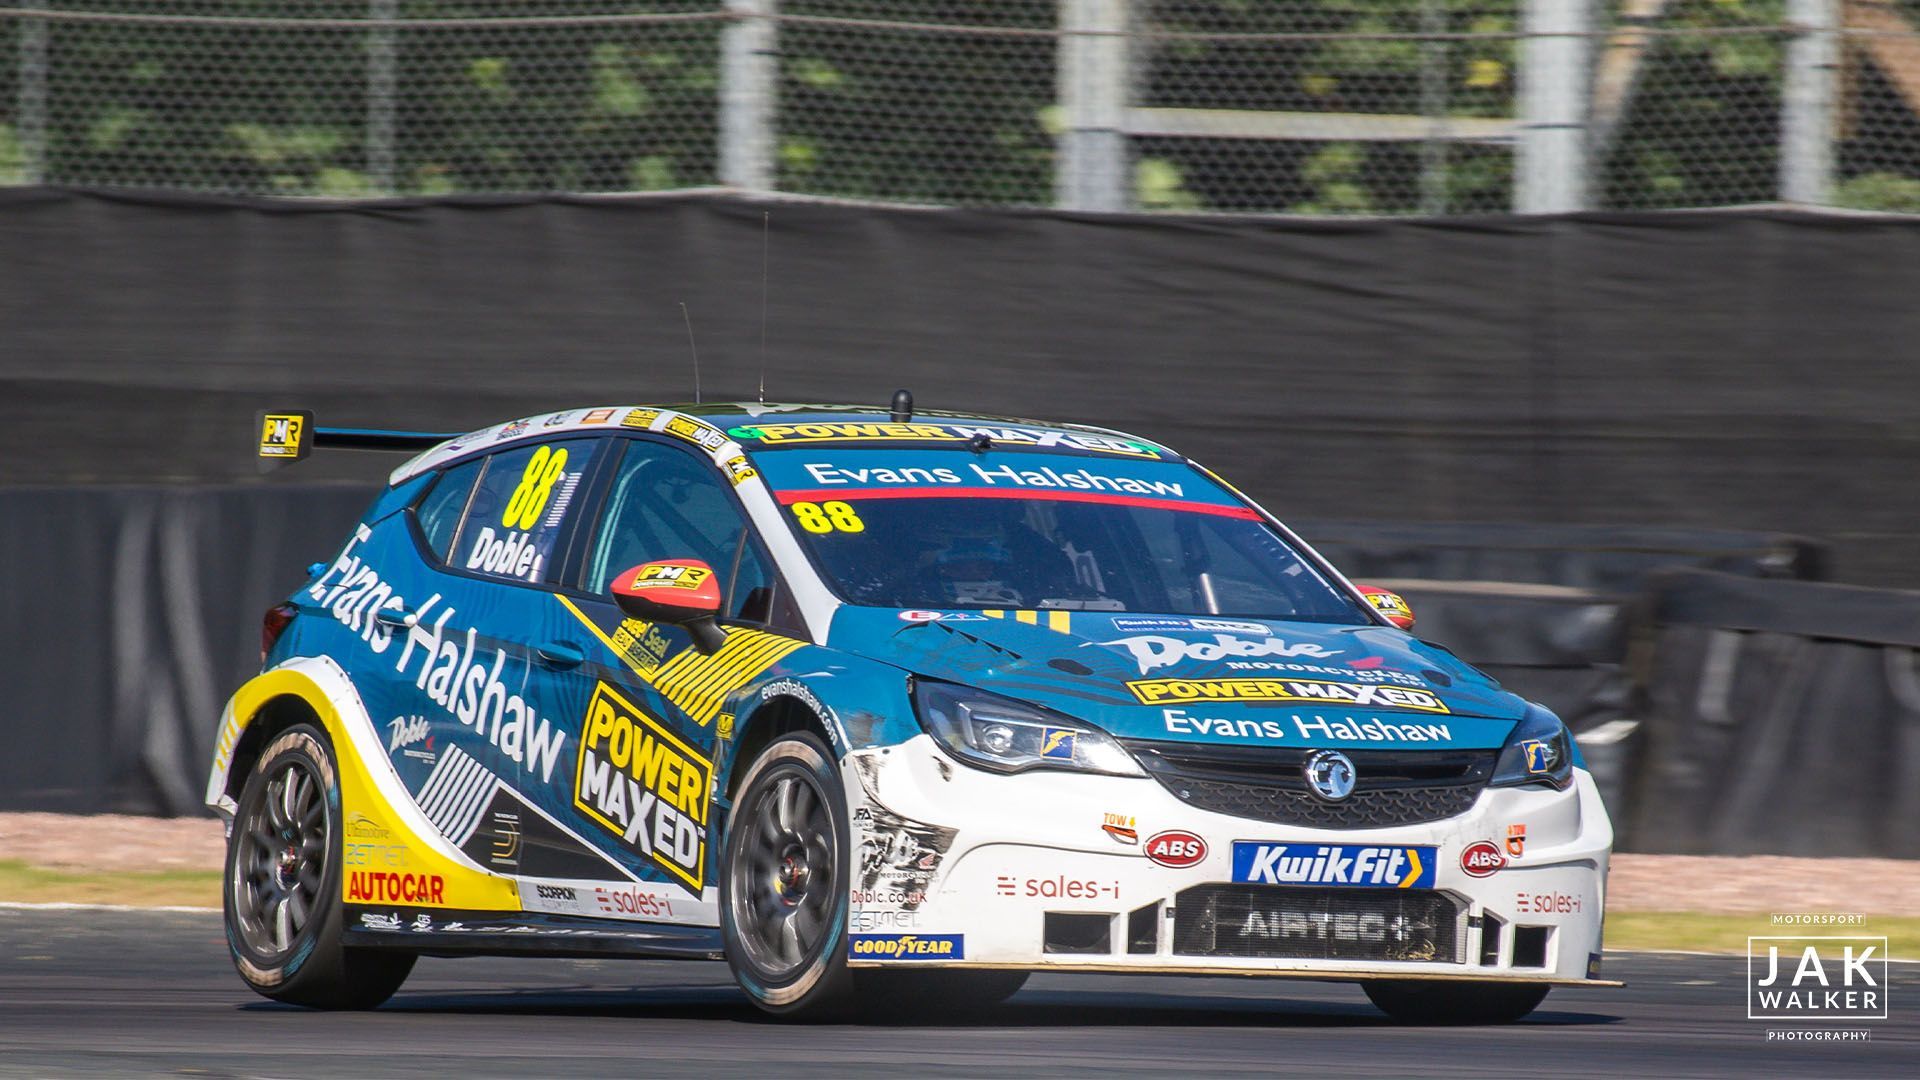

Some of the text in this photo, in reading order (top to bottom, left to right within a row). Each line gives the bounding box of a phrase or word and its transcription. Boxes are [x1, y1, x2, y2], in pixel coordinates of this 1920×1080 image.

[264, 418, 299, 442] PMR
[763, 424, 1142, 453] POWER MAXED
[502, 445, 568, 530] 88
[804, 463, 1184, 497] Evans Halshaw
[791, 501, 865, 534] 88
[466, 527, 536, 577] Doble
[639, 566, 705, 580] PMR
[309, 523, 566, 784] Evans Halshaw
[1079, 634, 1346, 676] Doble
[1226, 661, 1424, 682] MOTORCYCLES
[1137, 682, 1438, 707] POWER MAXED
[761, 677, 838, 746] evanshalshaw.com
[1163, 708, 1452, 742] Evans Halshaw
[387, 715, 431, 756] Doble
[588, 697, 702, 822] POWER
[581, 750, 699, 869] MAXED
[1104, 813, 1127, 826] TOW
[1153, 840, 1200, 858] ABS
[1468, 851, 1502, 867] ABS
[348, 871, 444, 904] AUTOCAR
[537, 885, 577, 900] SCORPION
[613, 886, 673, 916] sales-i
[1025, 875, 1119, 899] sales-i
[1534, 891, 1582, 913] sales-i
[1239, 910, 1385, 941] AIRTEC
